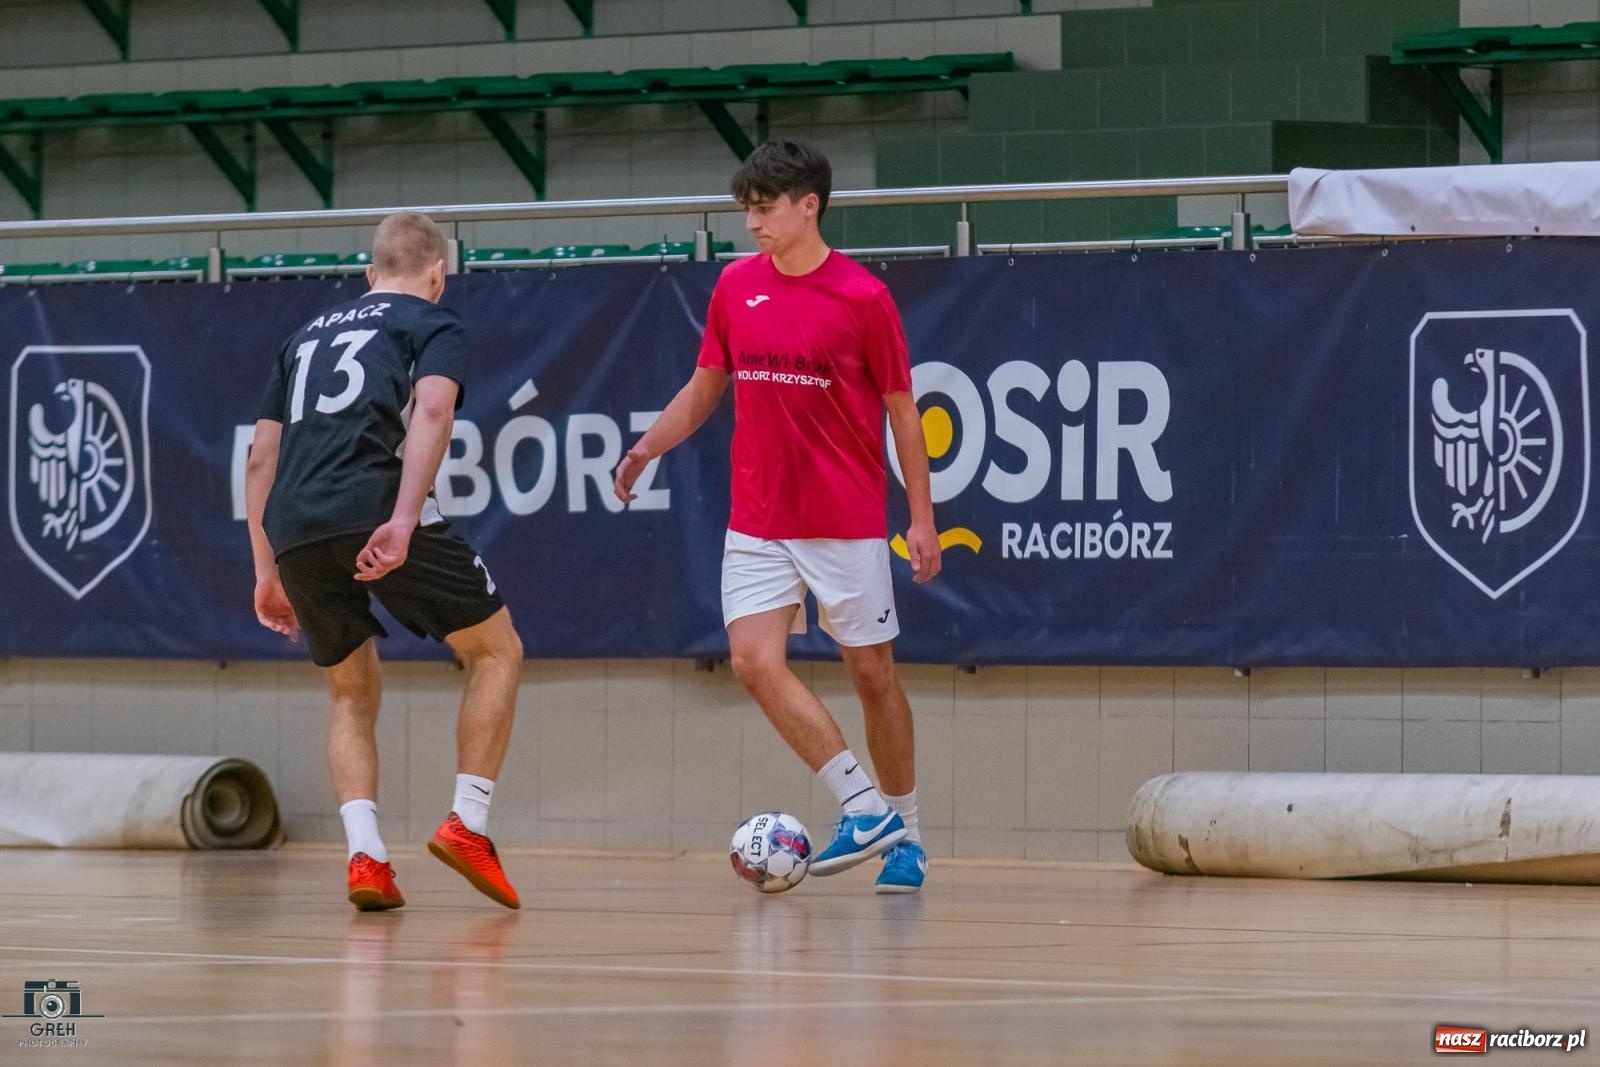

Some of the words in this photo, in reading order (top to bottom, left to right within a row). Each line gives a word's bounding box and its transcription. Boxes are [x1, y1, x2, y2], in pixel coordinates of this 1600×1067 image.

[306, 302, 392, 332] APACZ
[290, 329, 379, 424] 13
[772, 372, 832, 388] KRZYSZTOF
[231, 379, 671, 521] BÓRZ
[1001, 508, 1173, 559] RACIBÓRZ
[750, 816, 768, 857] SELECT
